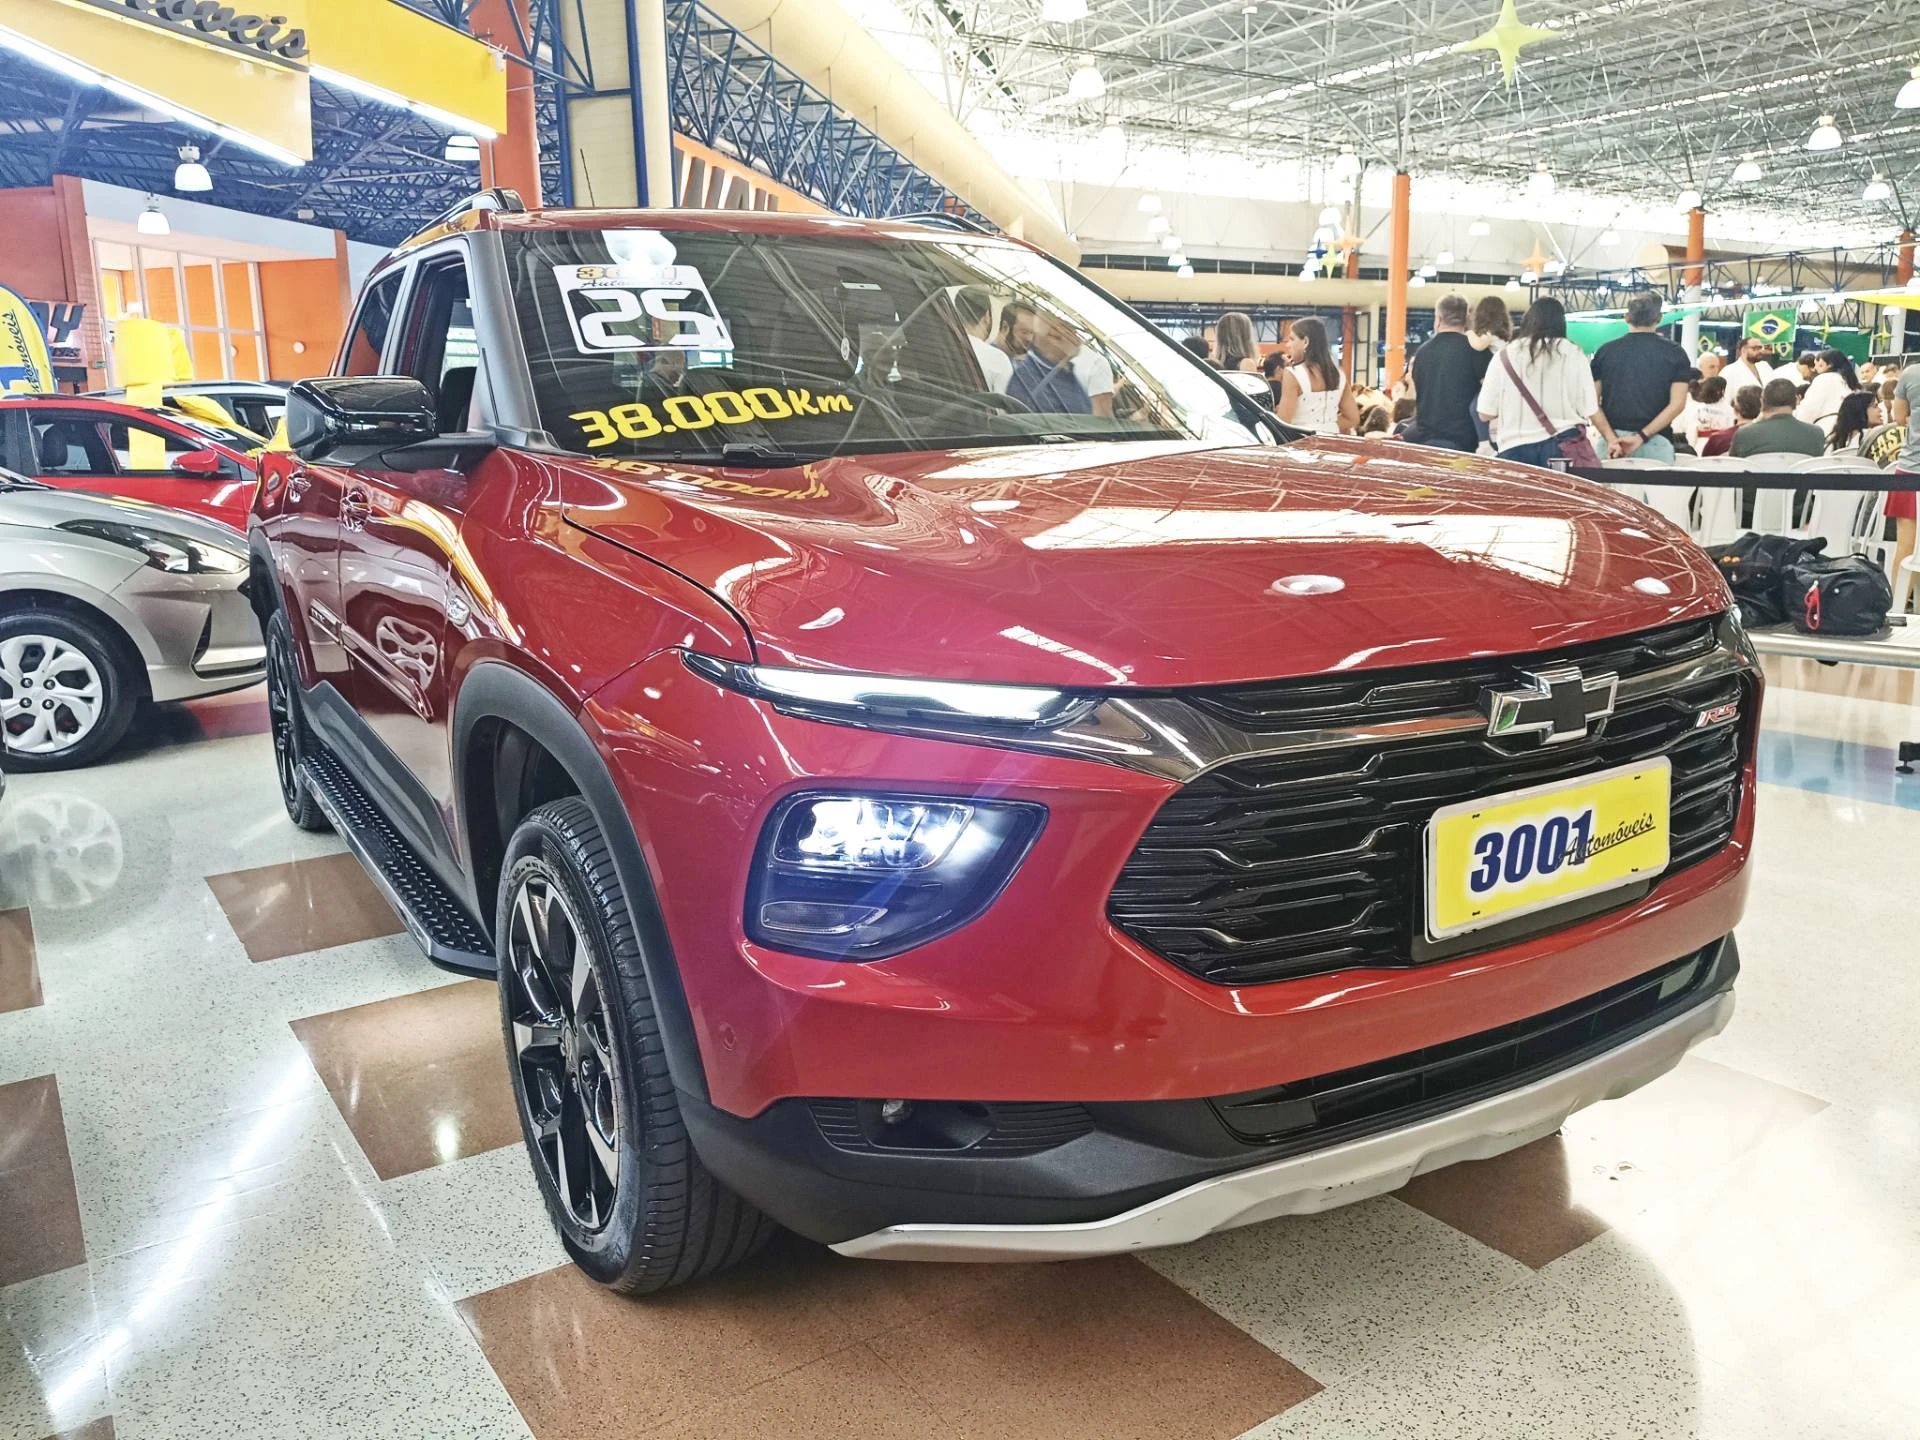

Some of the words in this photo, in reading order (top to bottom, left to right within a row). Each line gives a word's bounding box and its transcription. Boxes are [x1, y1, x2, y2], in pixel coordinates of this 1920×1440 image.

[579, 289, 722, 348] 25
[1696, 700, 1738, 728] RS
[1470, 809, 1593, 893] 3001
[1556, 812, 1656, 867] Automóveis
